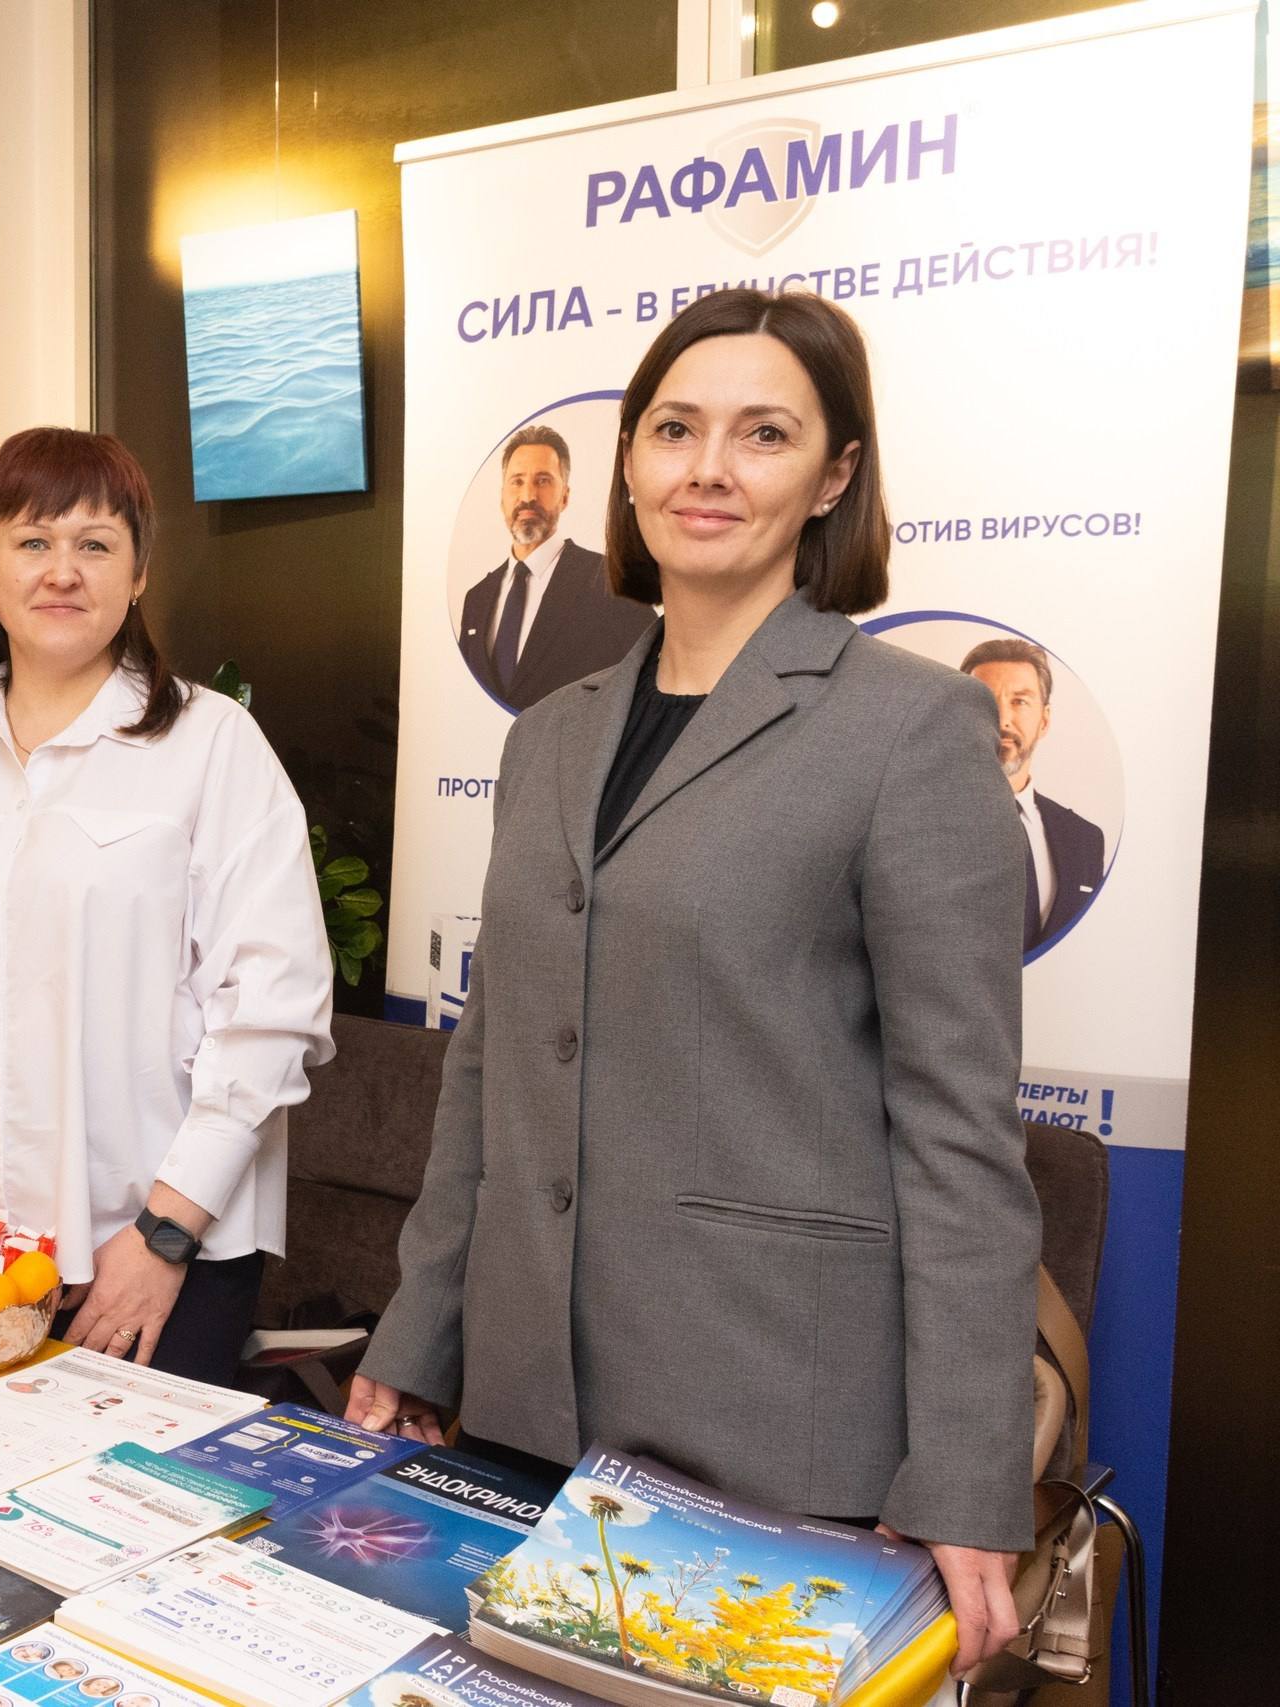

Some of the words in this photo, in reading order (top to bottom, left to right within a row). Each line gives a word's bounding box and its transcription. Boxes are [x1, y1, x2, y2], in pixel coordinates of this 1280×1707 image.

[457, 286, 593, 343] СИЛА
[636, 292, 658, 322] В
[893, 232, 1158, 299] ДЕЙСТВИЯ!
[981, 513, 1141, 541] ВИРУСОВ!
[438, 777, 499, 798] ПРОТ
[626, 1485, 687, 1514] Журнал
[635, 1471, 724, 1509] Российский
[632, 1479, 782, 1535] Аллергологический
[467, 1680, 542, 1707] Аллерго
